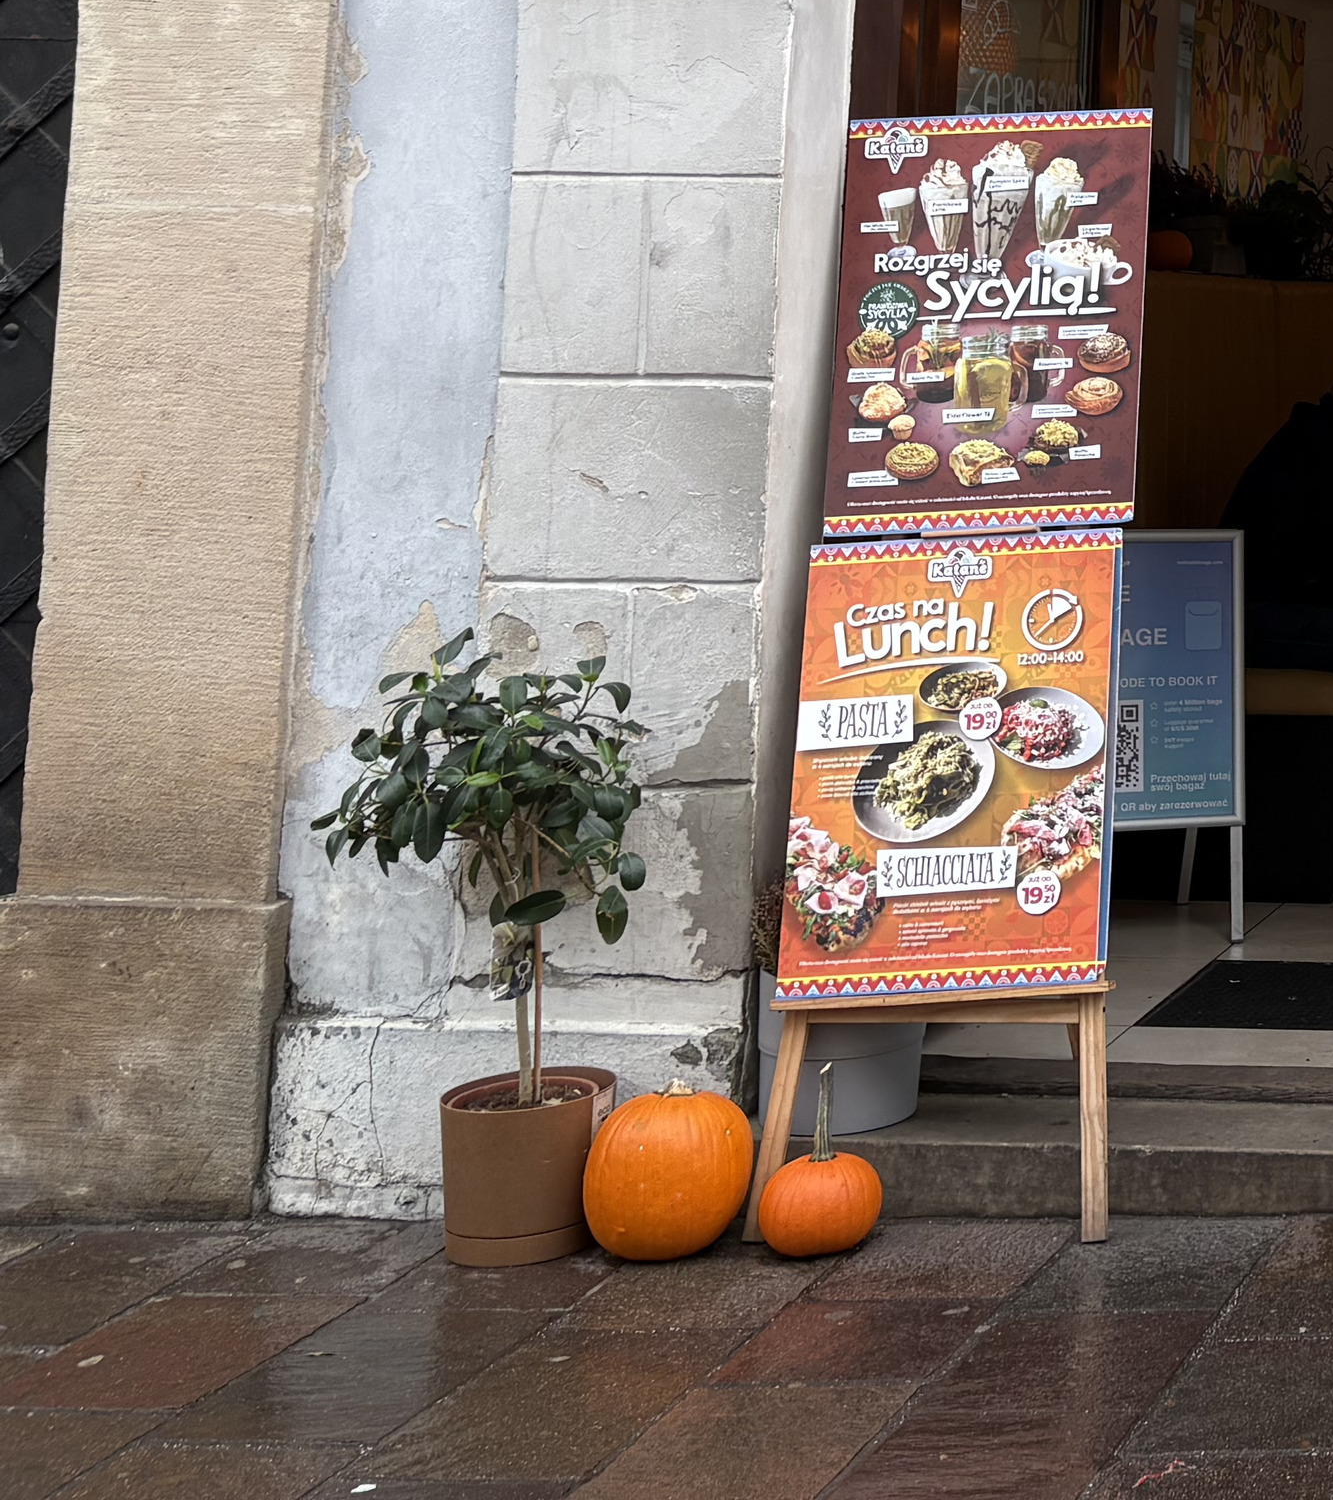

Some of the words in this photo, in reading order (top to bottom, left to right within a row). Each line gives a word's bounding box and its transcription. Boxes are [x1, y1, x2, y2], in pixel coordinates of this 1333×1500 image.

[874, 247, 969, 276] Rozgrzej
[972, 255, 1003, 277] się
[923, 262, 1101, 322] Sycylią!
[846, 602, 906, 627] Czas
[912, 598, 945, 617] na
[833, 601, 994, 668] Lunch!
[1120, 627, 1168, 647] AGE
[1017, 650, 1084, 666] 12:00-14:00
[1120, 677, 1146, 688] ODE
[1148, 677, 1165, 687] TO
[1168, 676, 1204, 687] BOOK
[1207, 675, 1218, 686] IT
[835, 700, 890, 740] PASTA
[964, 713, 985, 730] 19
[985, 710, 998, 719] 00
[1150, 772, 1207, 784] Przechowaj
[1209, 771, 1231, 782] tutaj
[1151, 782, 1174, 793] swój
[1175, 781, 1206, 792] bagaż
[1120, 802, 1136, 812] QR
[1139, 802, 1157, 813] aby
[1160, 797, 1229, 811] zarezerwować
[896, 851, 996, 888] SCHIACCIATA
[1021, 886, 1043, 905] 19
[1044, 884, 1056, 893] 50
